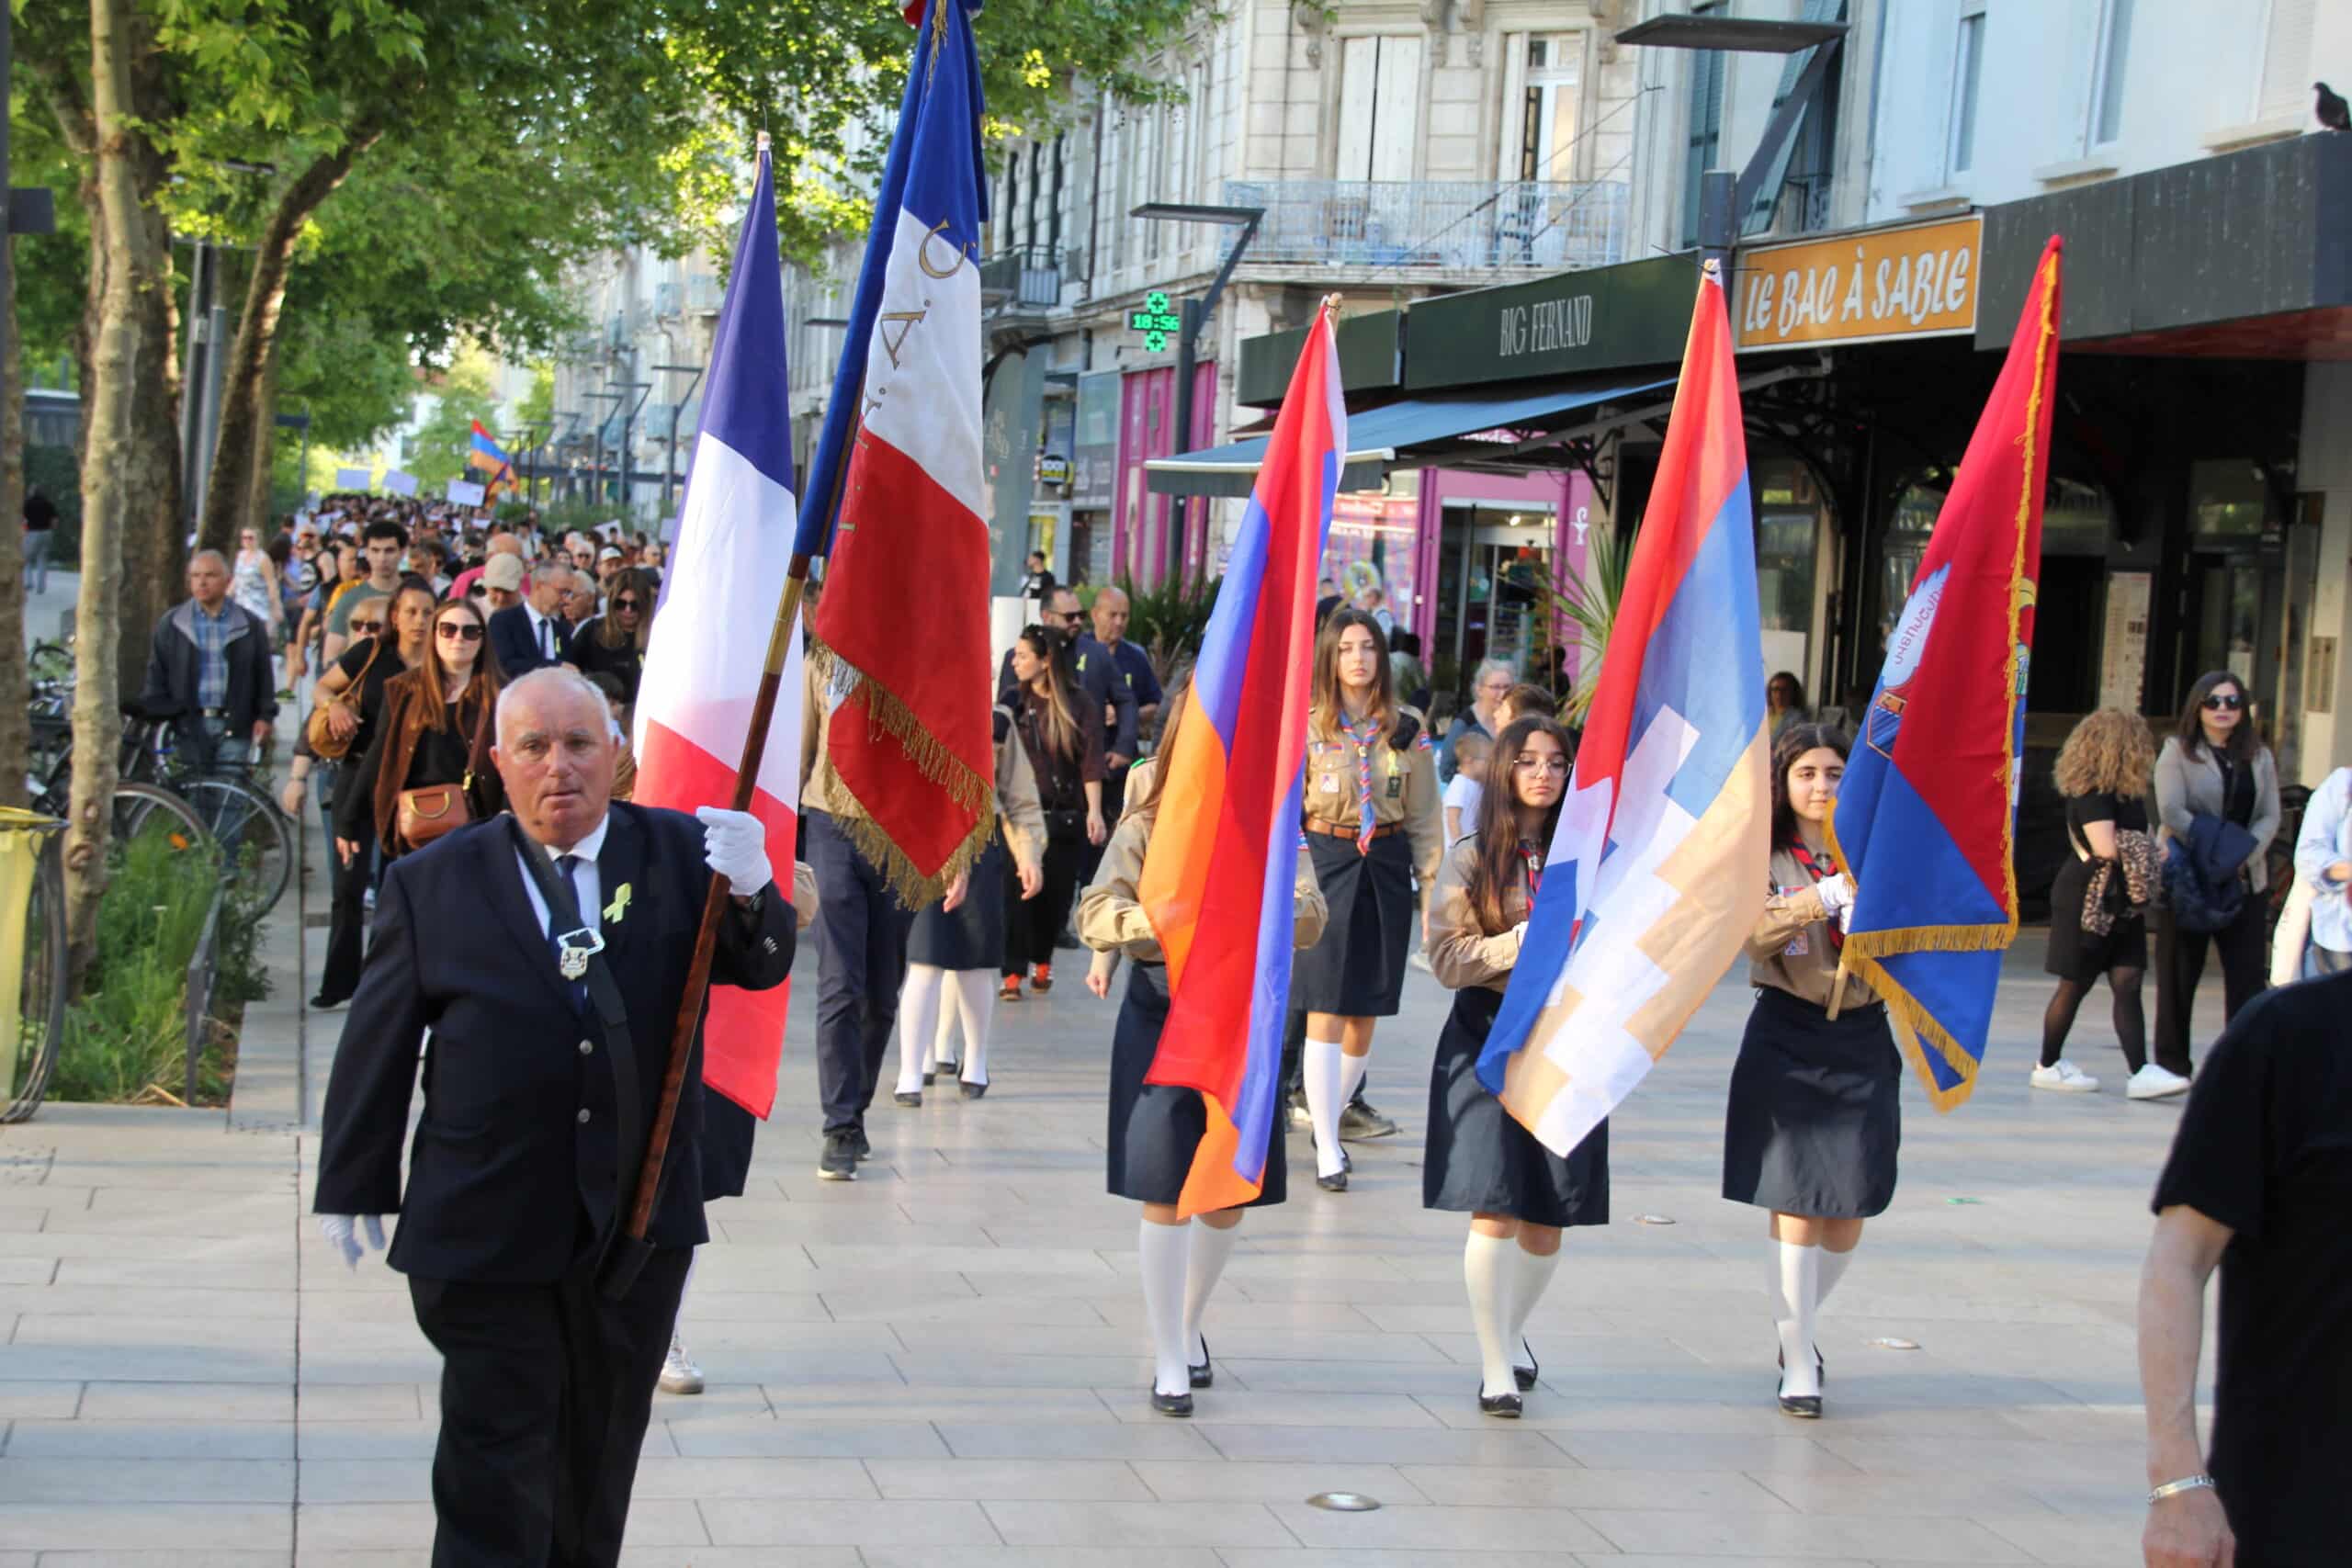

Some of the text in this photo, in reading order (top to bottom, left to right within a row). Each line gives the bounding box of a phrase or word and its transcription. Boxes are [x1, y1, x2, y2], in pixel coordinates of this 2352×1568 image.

[1746, 244, 1970, 338] LE BAC À SABLE
[1132, 313, 1180, 332] 18:56
[1498, 294, 1593, 356] BIG FERNAND
